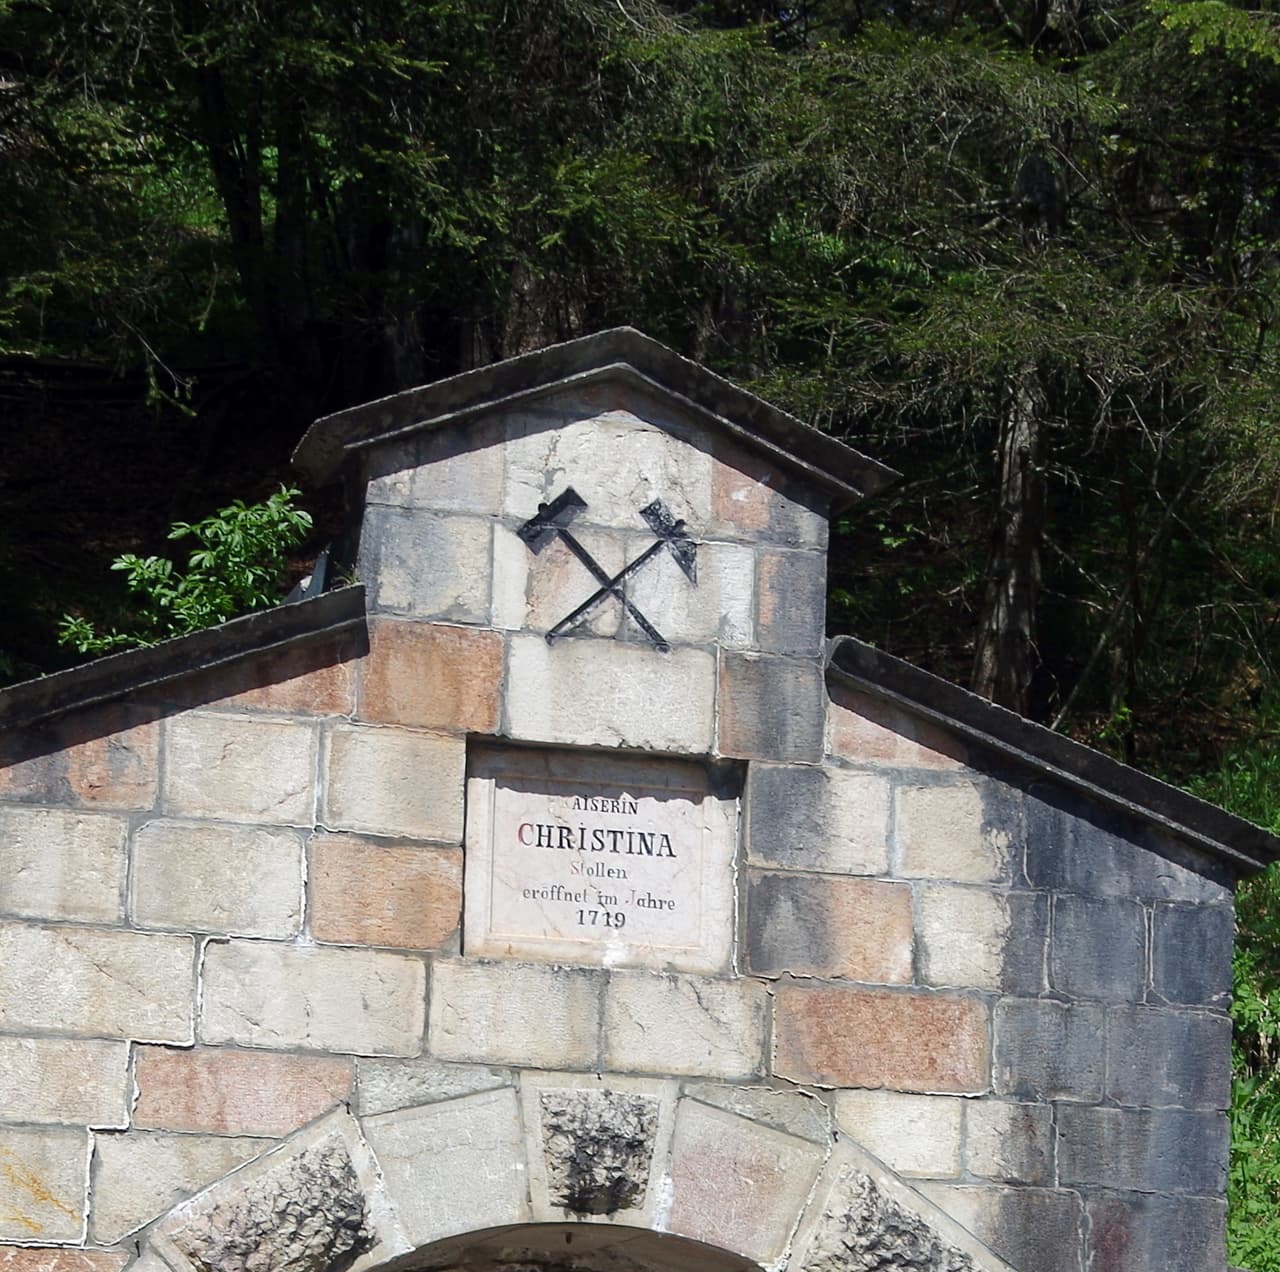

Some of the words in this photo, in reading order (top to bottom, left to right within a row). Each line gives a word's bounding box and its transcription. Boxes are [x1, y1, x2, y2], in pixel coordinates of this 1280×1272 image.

[518, 822, 677, 858] CHRISTINA
[571, 861, 628, 880] Stollen
[522, 885, 587, 904] eröffnet
[597, 891, 618, 906] im
[625, 889, 676, 910] Jahre
[576, 909, 626, 928] 1719
